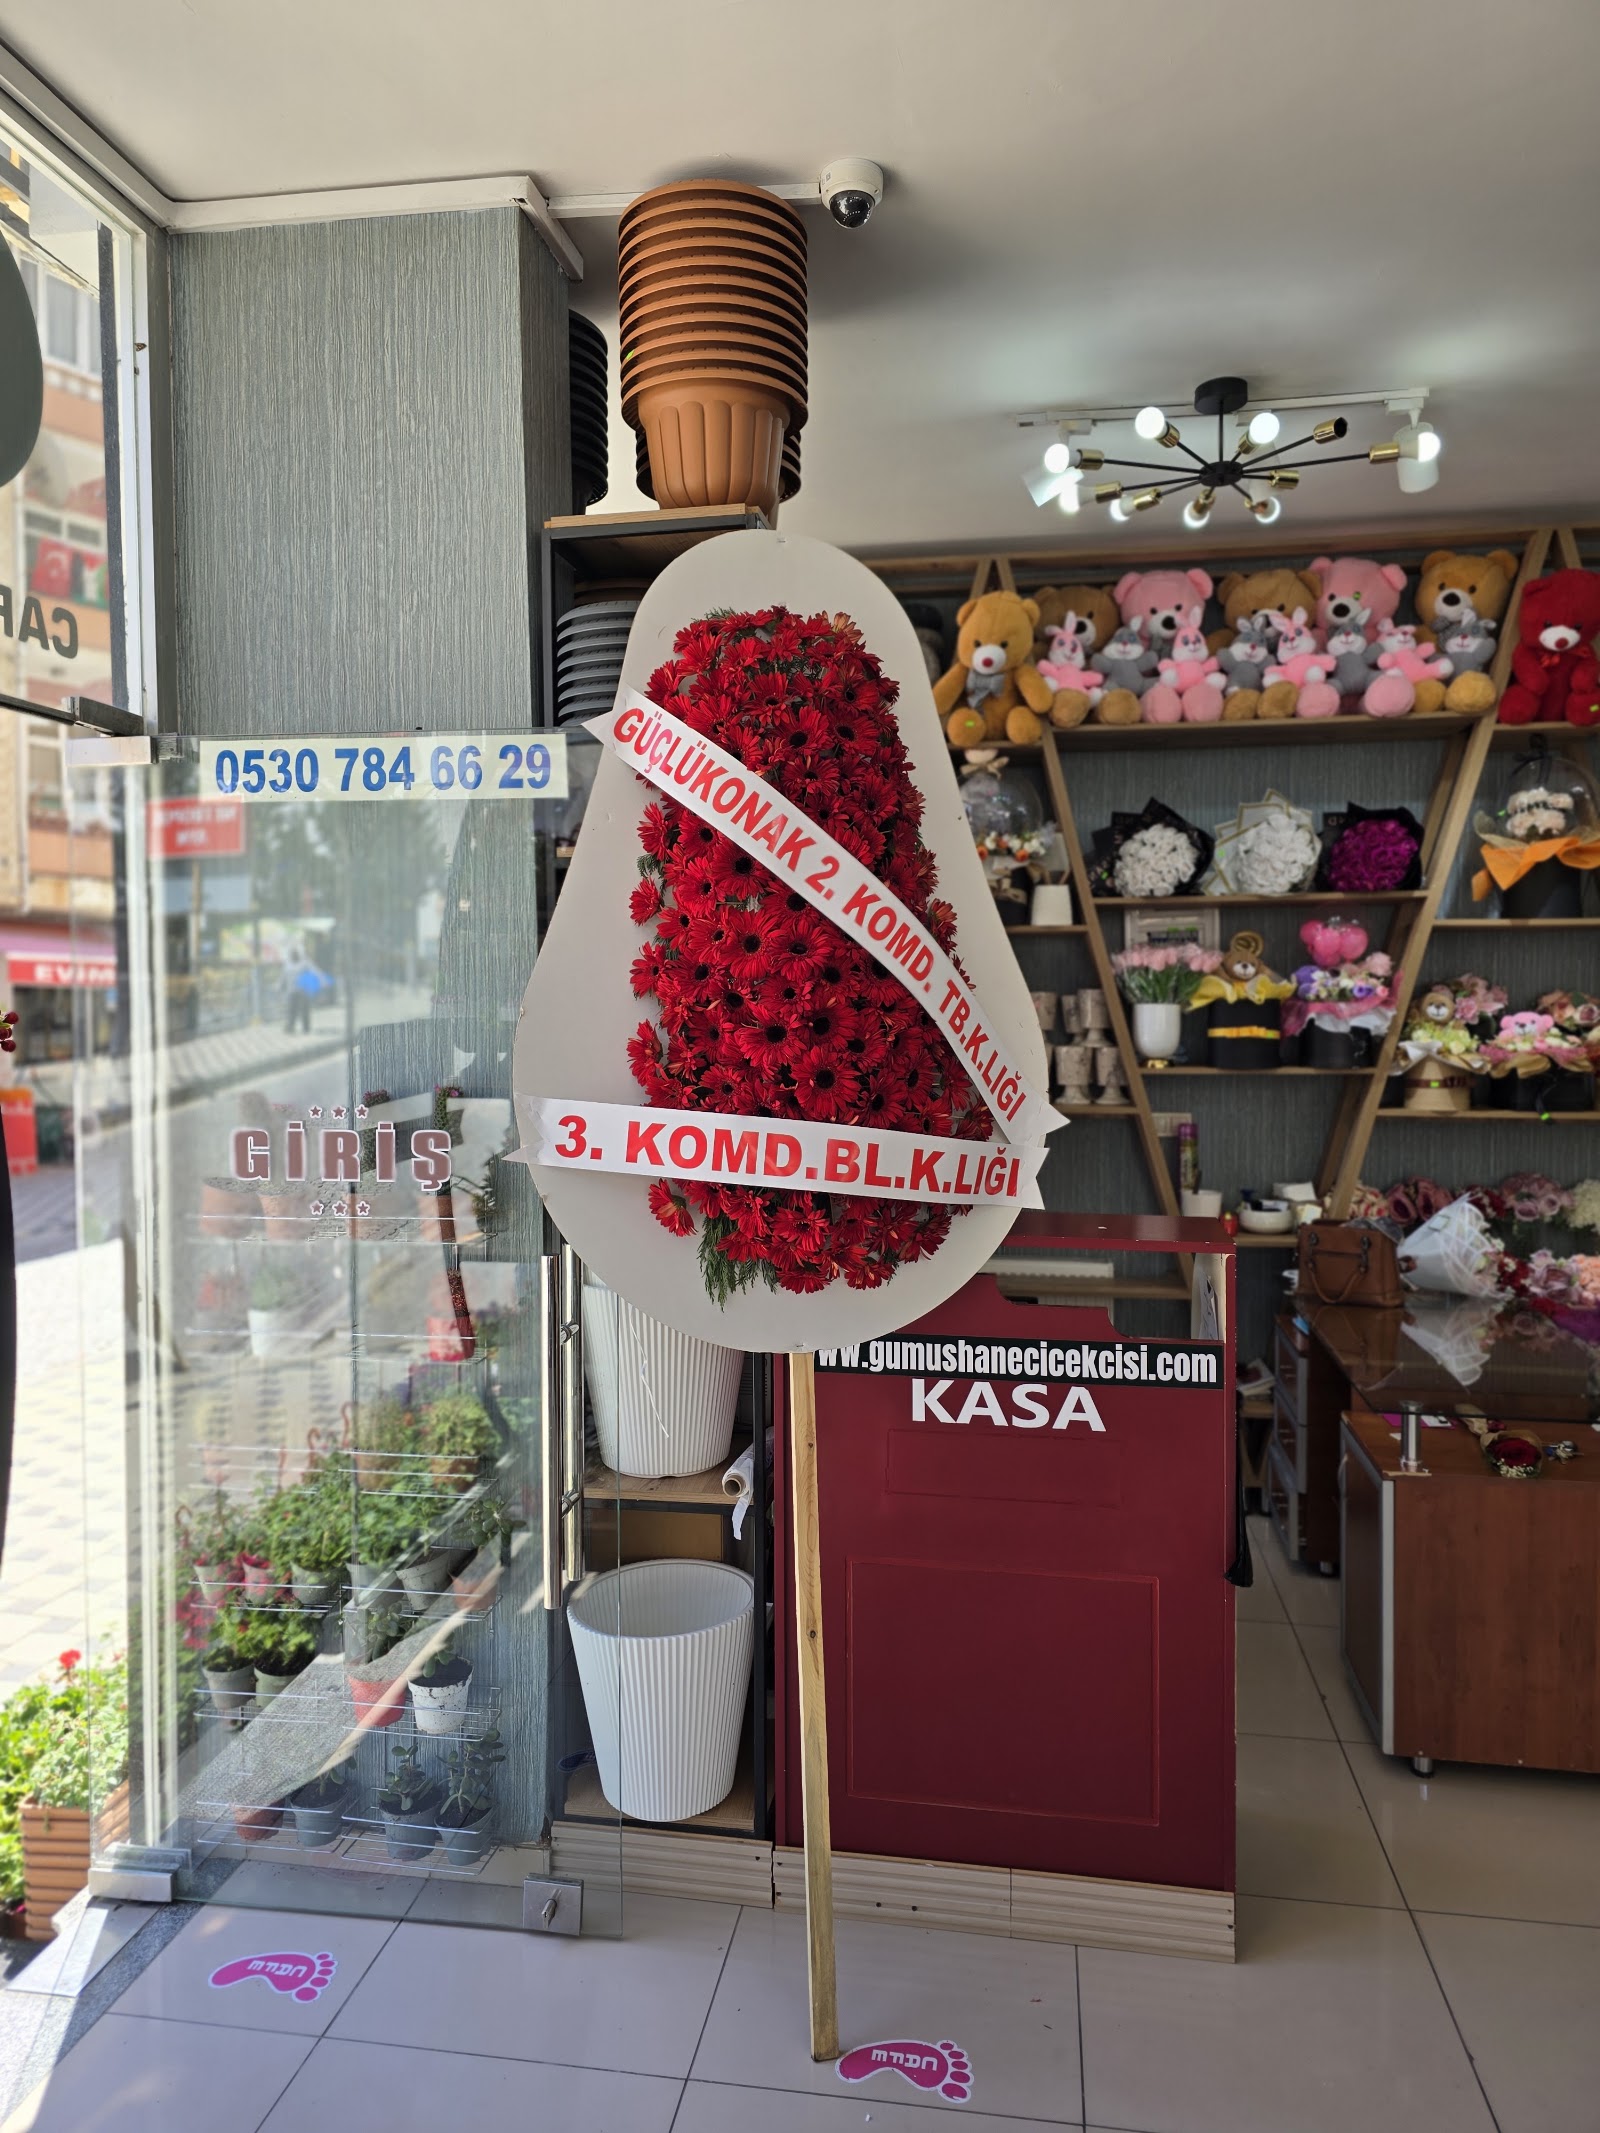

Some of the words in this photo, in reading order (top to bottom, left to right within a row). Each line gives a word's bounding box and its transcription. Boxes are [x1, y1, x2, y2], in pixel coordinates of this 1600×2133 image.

[215, 749, 319, 793] 0530
[335, 746, 415, 791] 784
[430, 745, 482, 790] 66
[498, 743, 551, 789] 29
[613, 708, 816, 872] GÜÇLÜKONAK
[805, 856, 840, 901] 2.
[842, 883, 934, 993] KOMD.
[939, 979, 1026, 1122] TB.K.LIĞI
[232, 1121, 452, 1191] GİRİŞ
[555, 1115, 602, 1160] 3.
[625, 1120, 1020, 1197] KOMD.BL.K.LIĞI
[818, 1339, 1217, 1383] ww.gumushanecicekcisi.com
[912, 1378, 1107, 1432] KASA
[871, 2049, 938, 2071] CAFE
